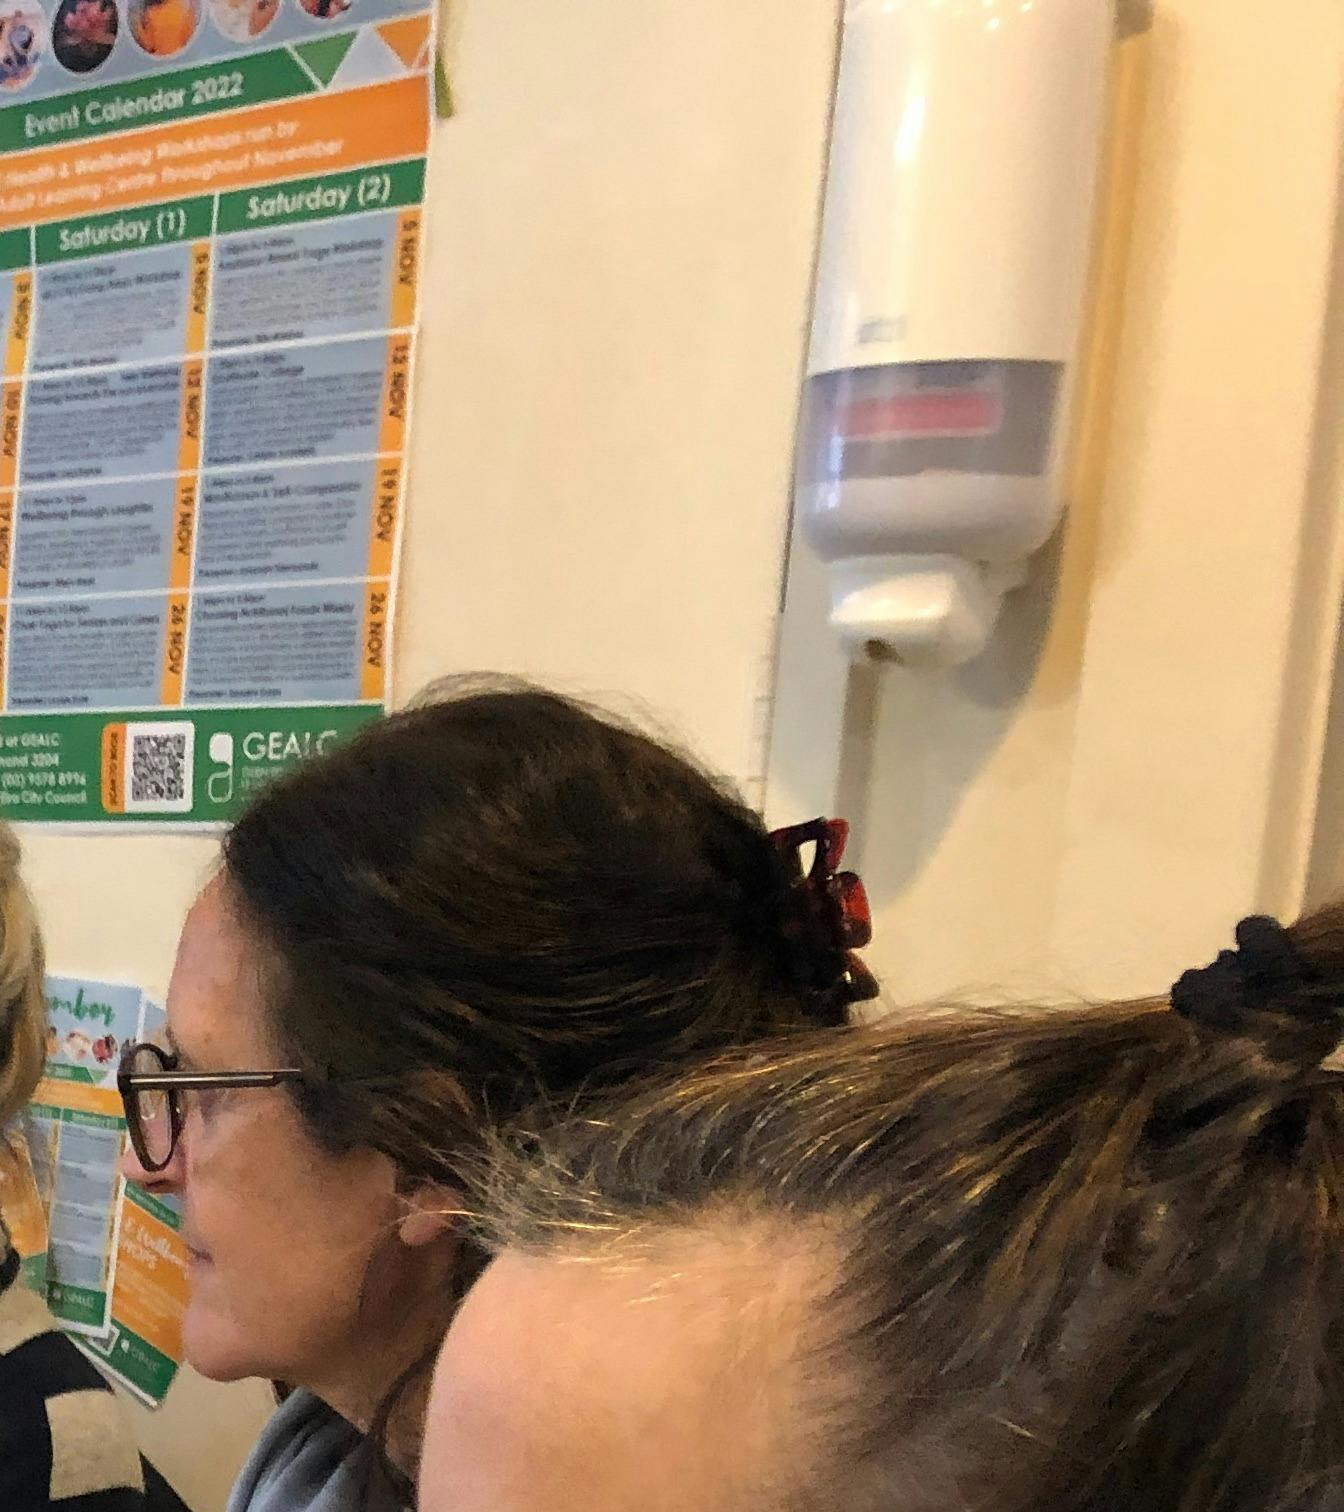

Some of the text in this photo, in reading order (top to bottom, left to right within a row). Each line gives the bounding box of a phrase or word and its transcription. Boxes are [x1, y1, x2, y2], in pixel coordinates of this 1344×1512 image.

[24, 71, 244, 139] Event Calendar 2022
[245, 173, 391, 219] Saturday (2)
[59, 207, 186, 251] Saturday (1)
[177, 512, 192, 555] NOV
[376, 495, 396, 542] NOV
[168, 631, 184, 675] NOV
[366, 592, 386, 668] 26 NOV
